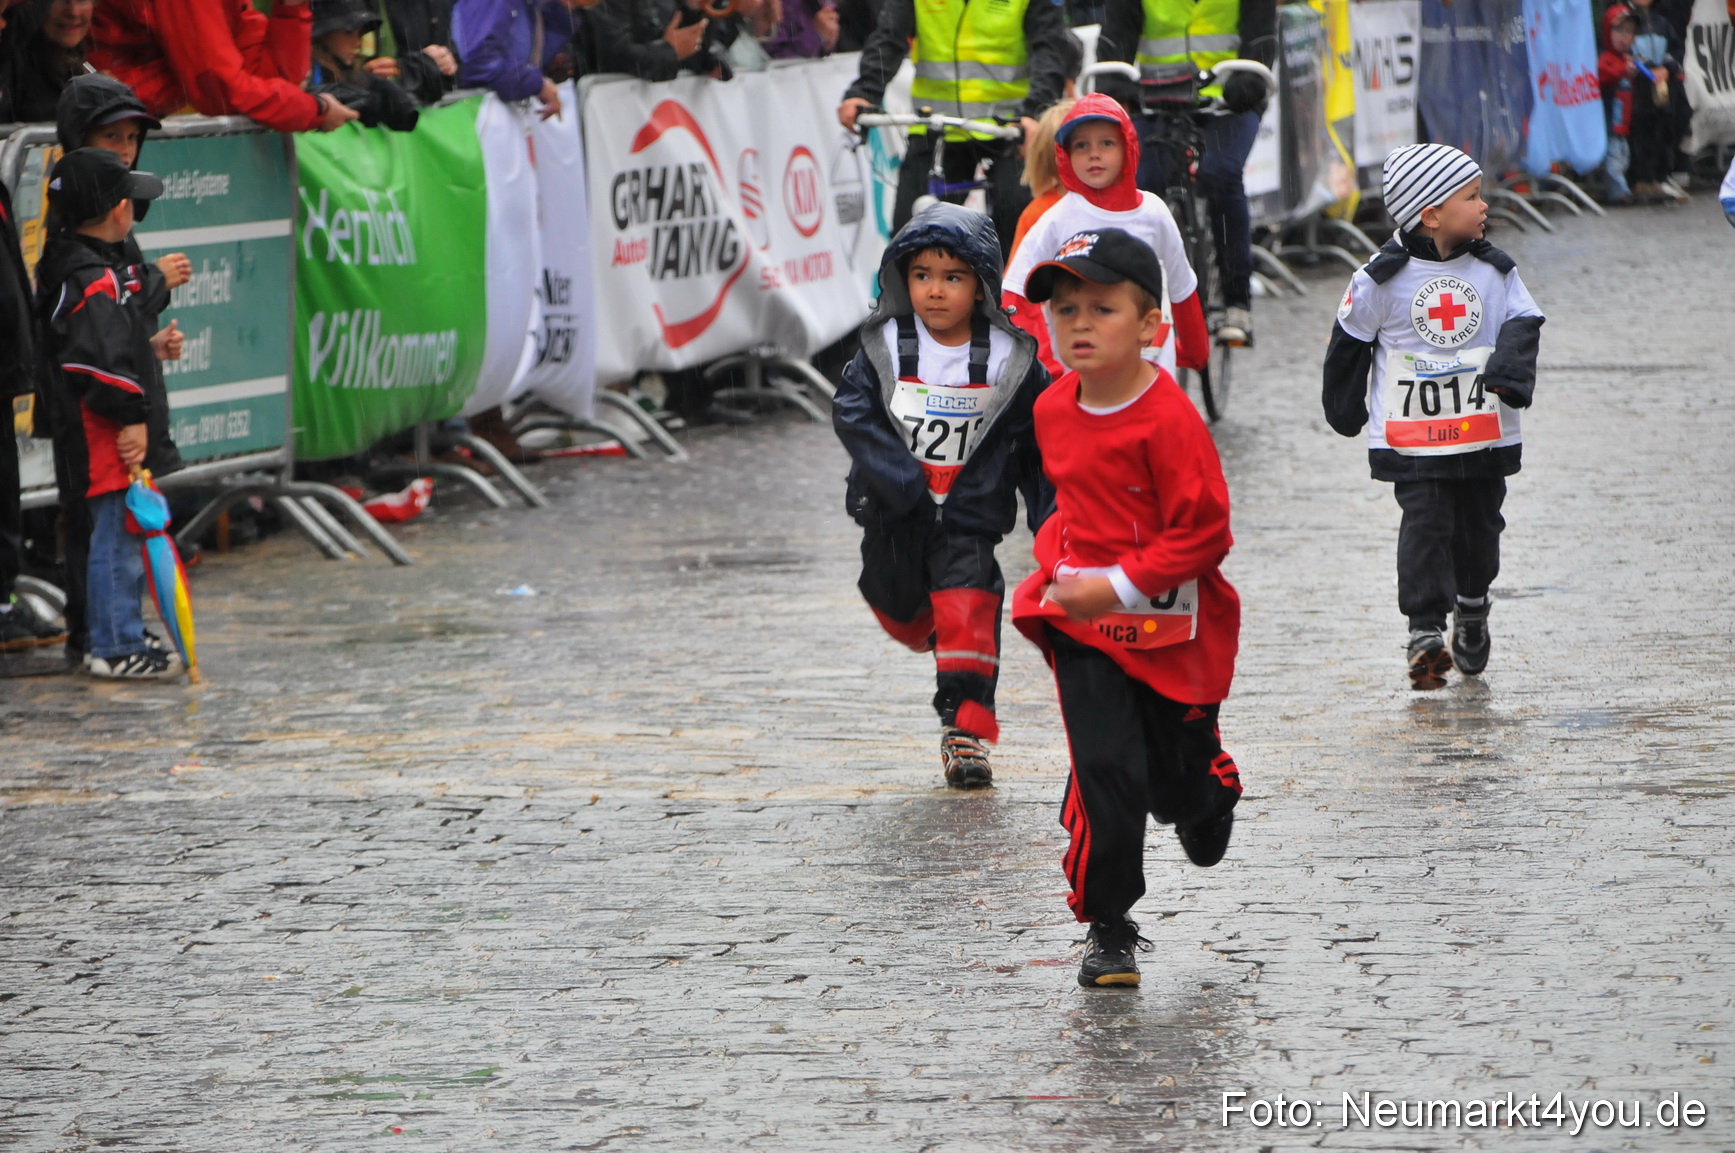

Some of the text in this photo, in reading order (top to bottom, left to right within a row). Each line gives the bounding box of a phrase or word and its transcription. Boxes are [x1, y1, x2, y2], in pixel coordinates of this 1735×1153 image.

[1415, 279, 1477, 308] DEUTSCHES
[1414, 311, 1480, 345] ROTES KREUZ
[1414, 357, 1462, 371] BOCK
[926, 394, 978, 410] BOCK
[1397, 374, 1486, 418] 7014
[1427, 424, 1460, 442] Luis
[1181, 602, 1191, 612] M
[1089, 618, 1138, 643] uca
